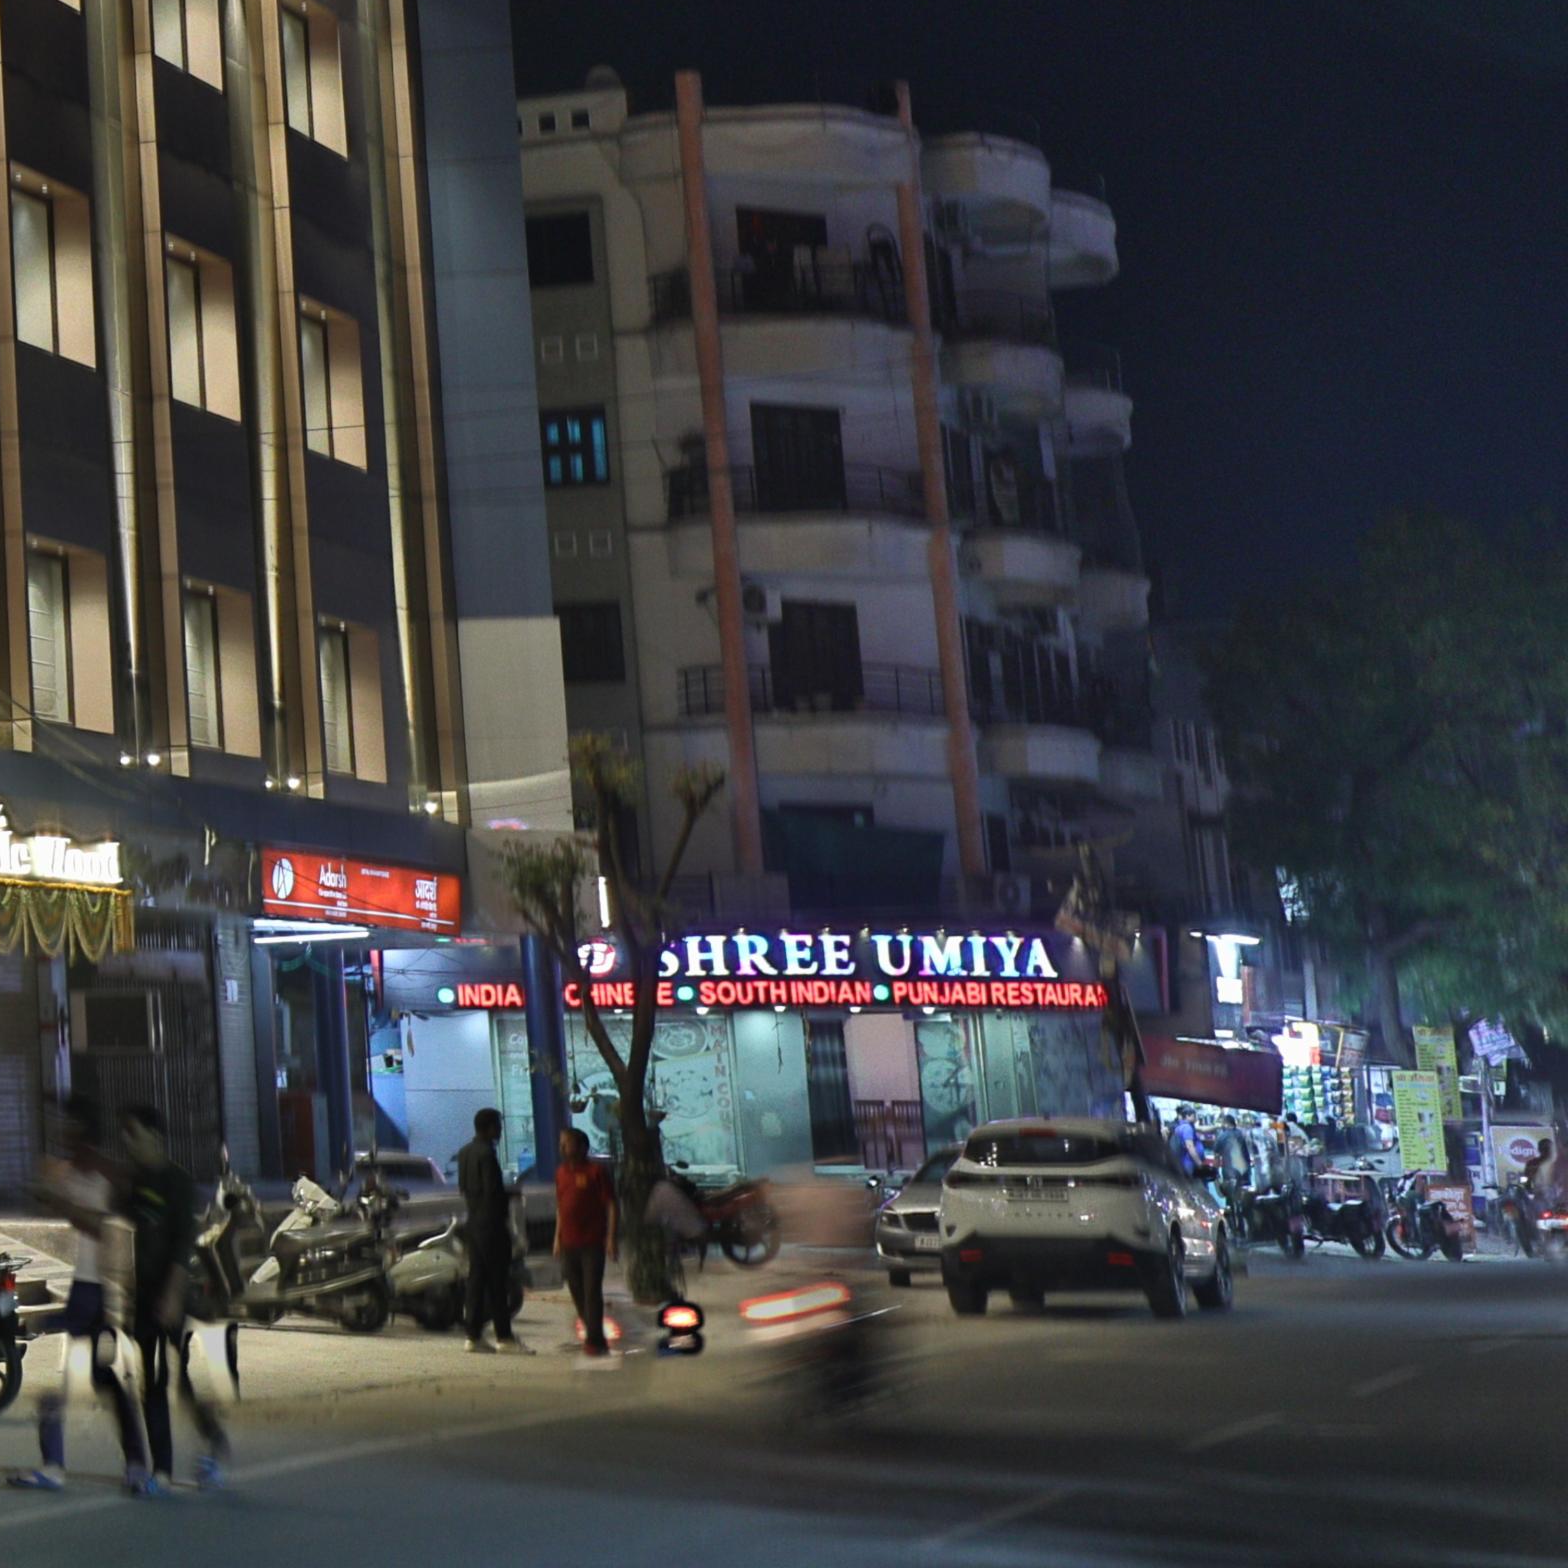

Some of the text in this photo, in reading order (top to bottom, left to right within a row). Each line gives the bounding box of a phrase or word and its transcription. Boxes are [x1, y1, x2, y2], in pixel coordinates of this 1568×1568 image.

[318, 862, 348, 889] Adarsh
[659, 934, 1058, 978] SHREE UMIYA
[457, 983, 525, 1007] INDIA
[564, 981, 674, 1007] CHINEE
[700, 981, 787, 1006] SOUTH
[790, 981, 871, 1004] INDIAN
[892, 981, 987, 1005] PUNJABI
